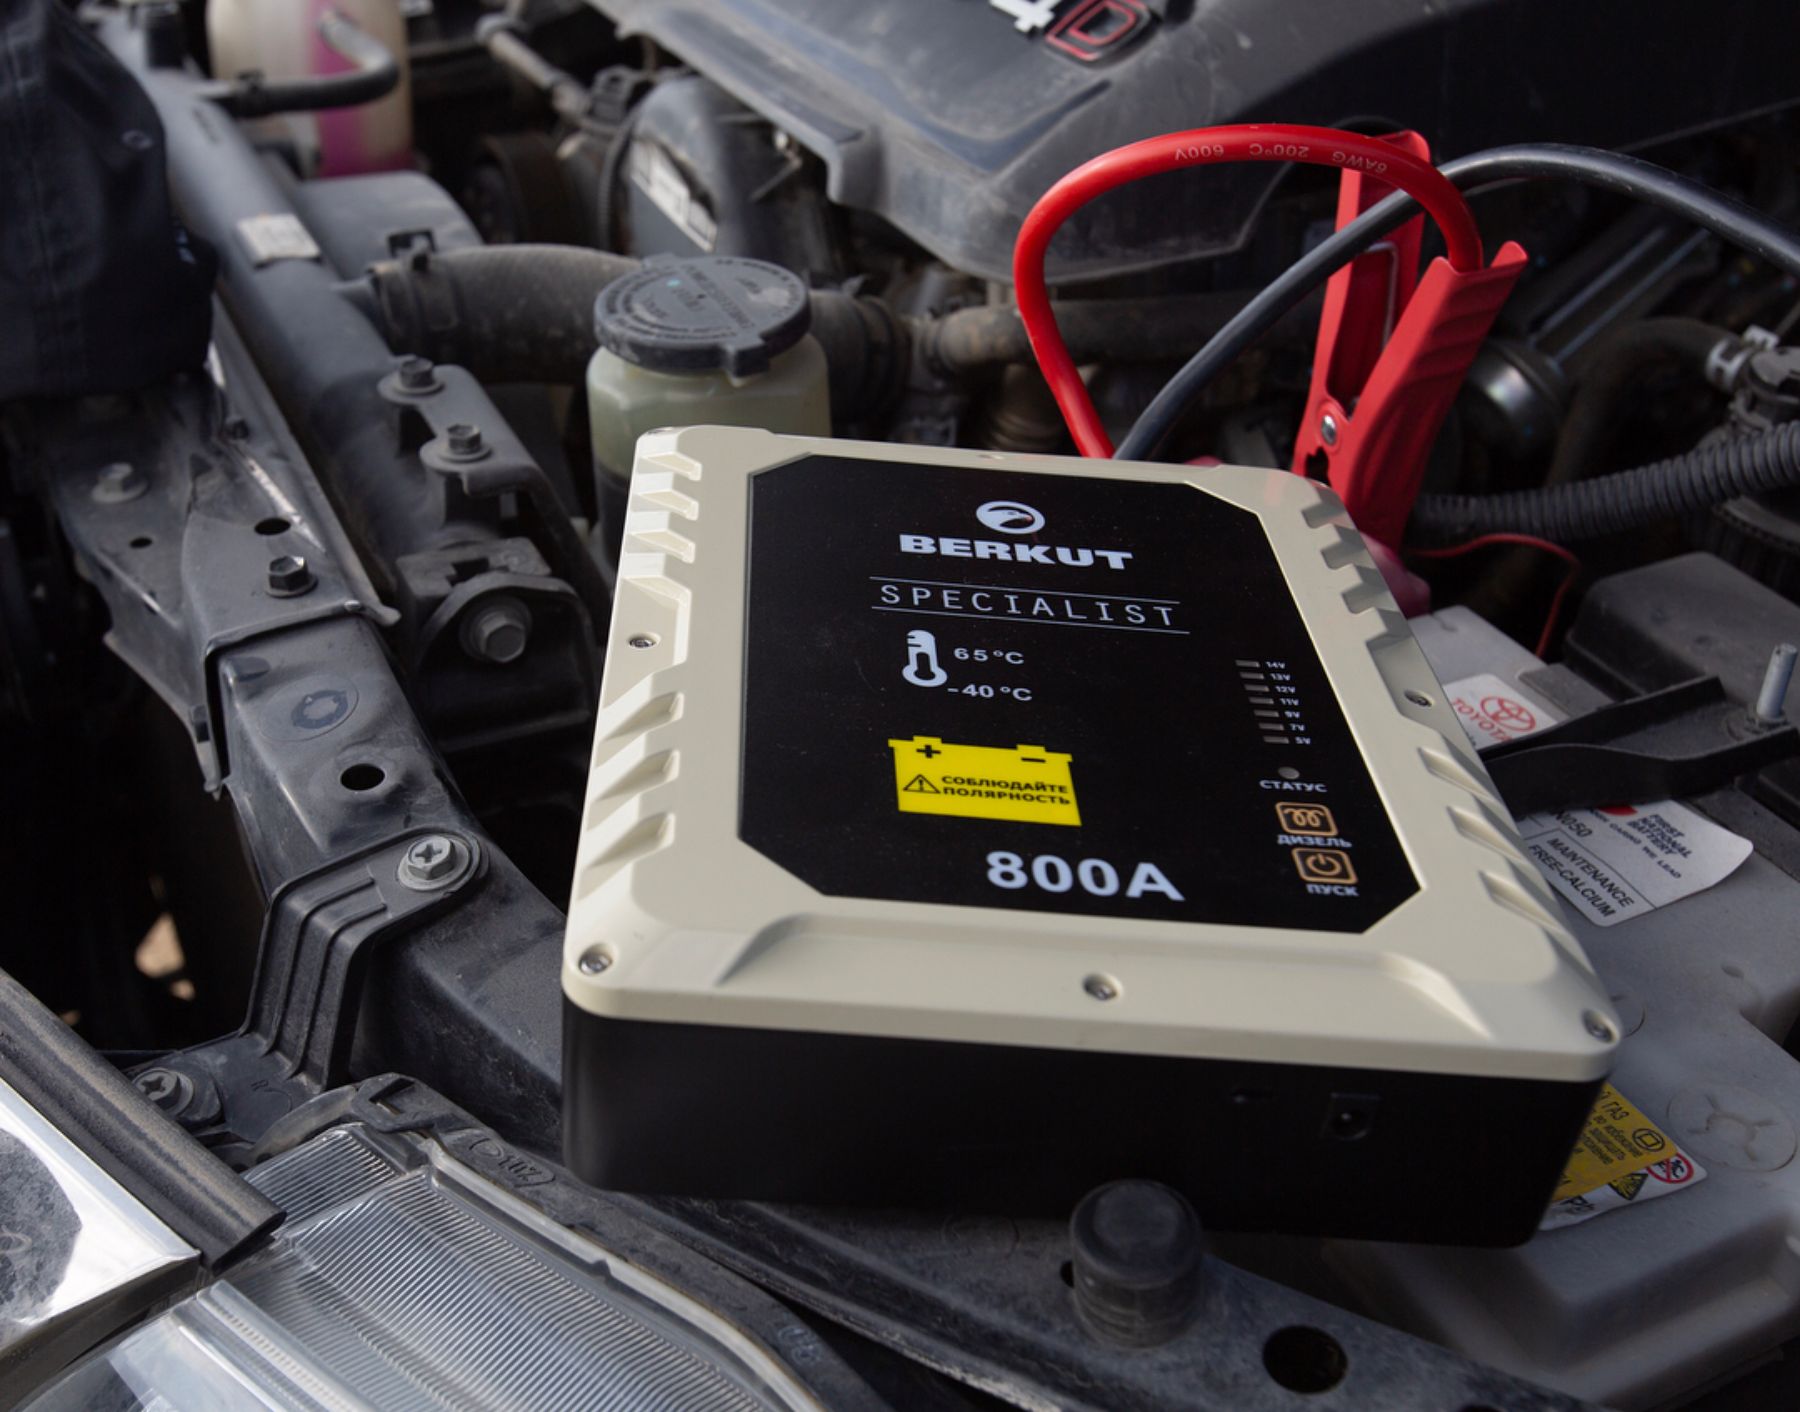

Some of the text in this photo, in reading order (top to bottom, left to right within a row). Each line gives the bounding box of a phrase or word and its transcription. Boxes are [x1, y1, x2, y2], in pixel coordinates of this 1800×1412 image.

[1175, 144, 1224, 161] 600V
[1331, 151, 1388, 175] 6AWG
[899, 534, 1133, 570] BERKUT
[880, 584, 1174, 626] SPECIALIST
[1275, 685, 1296, 693] 12V
[942, 775, 1068, 795] СОБЛЮДАЙТЕ
[1259, 780, 1327, 792] СТАТУС
[943, 786, 1070, 806] ПОЛЯРНОСТЬ
[1277, 834, 1352, 848] ДИЗЕЛЬ
[985, 850, 1186, 902] 800A
[1528, 844, 1616, 918] FREE-CALCIUM
[1547, 837, 1635, 908] MAINTENANCE
[1306, 884, 1359, 896] ПУСК
